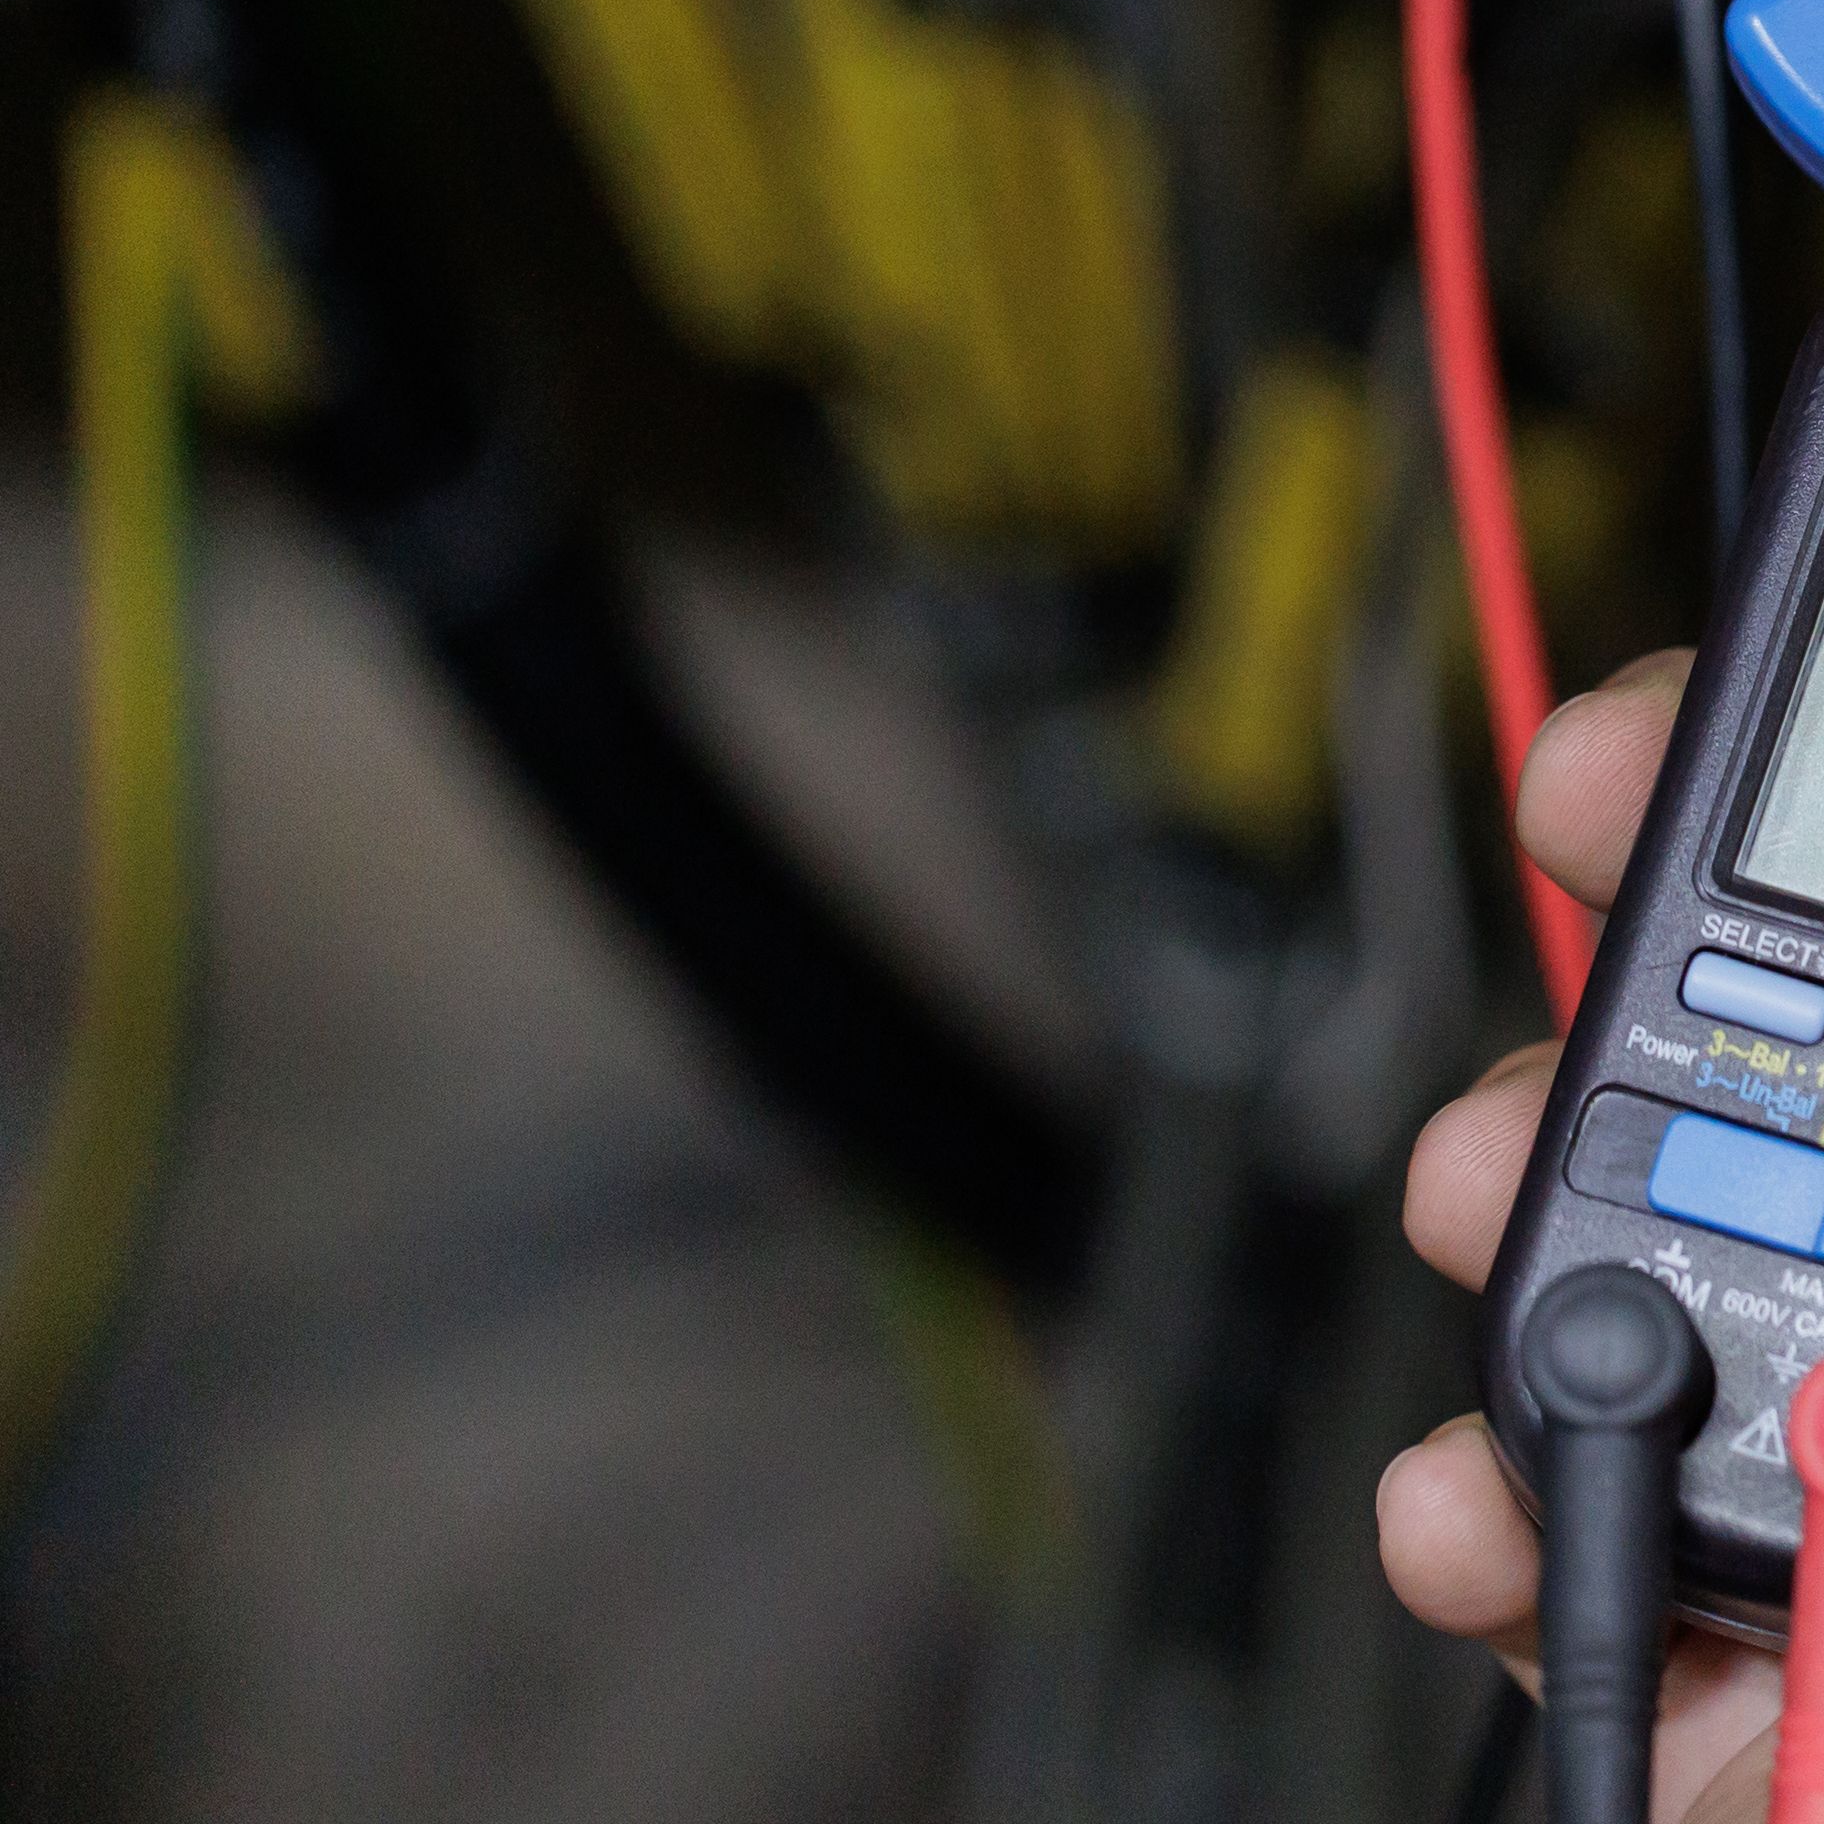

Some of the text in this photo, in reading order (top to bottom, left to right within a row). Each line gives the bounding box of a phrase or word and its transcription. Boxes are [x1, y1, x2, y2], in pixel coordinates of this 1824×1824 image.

[1700, 913, 1819, 967] SELECT
[1626, 1024, 1699, 1066] Power
[1721, 1287, 1792, 1327] 600V
